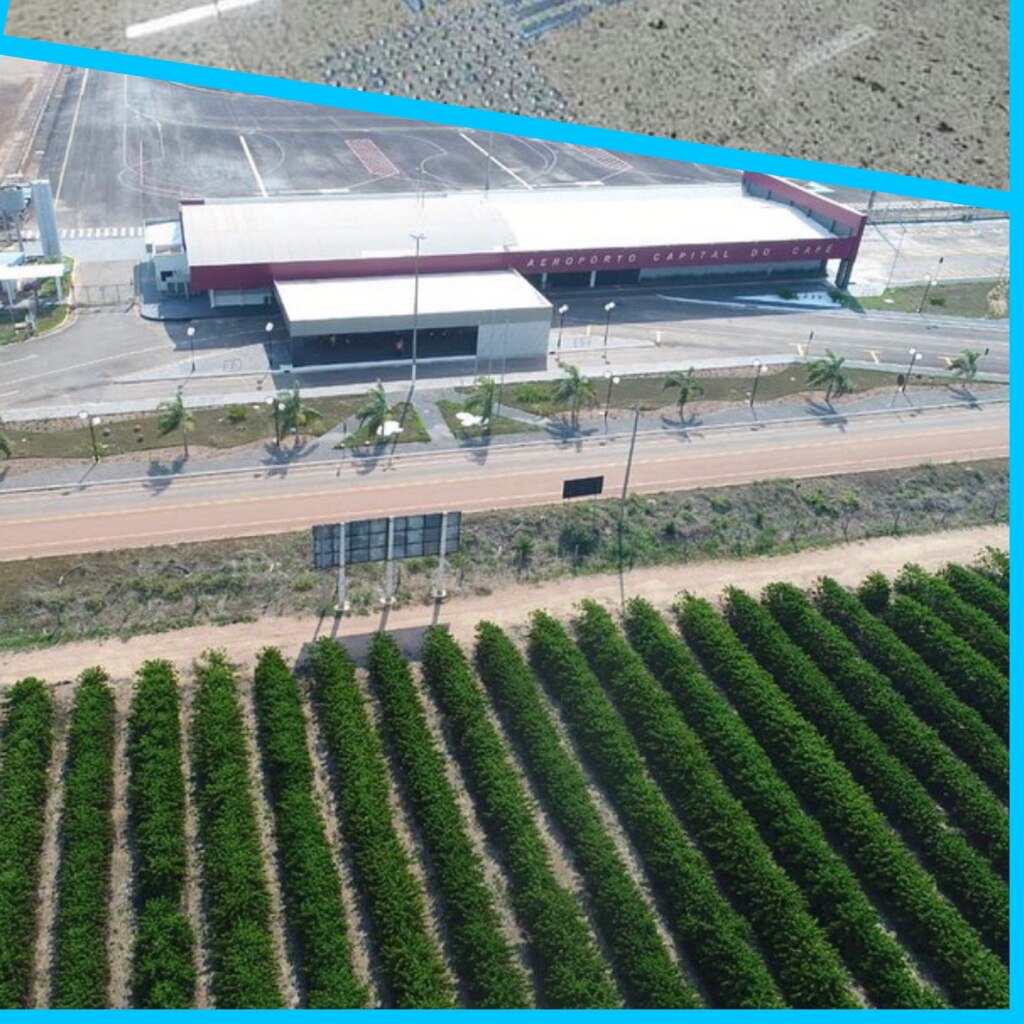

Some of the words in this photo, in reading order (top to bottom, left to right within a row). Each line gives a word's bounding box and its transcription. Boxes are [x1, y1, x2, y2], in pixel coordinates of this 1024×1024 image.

[526, 253, 637, 268] AEROPORTO
[653, 250, 731, 263] CAPITAL
[750, 247, 772, 258] DO
